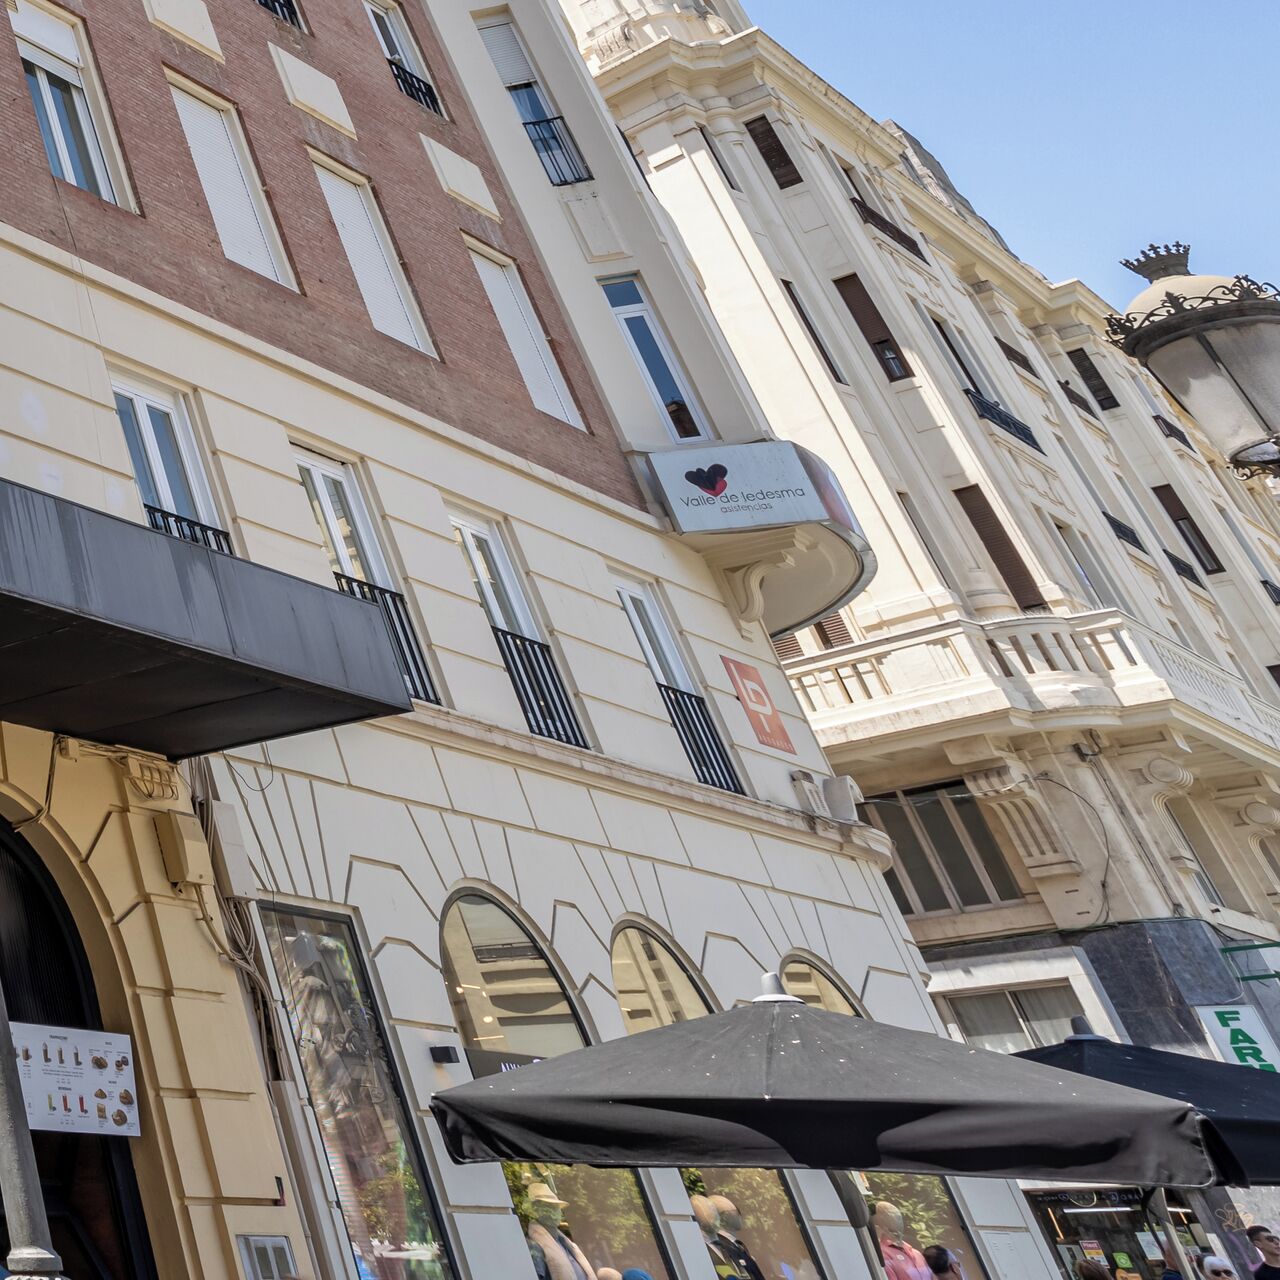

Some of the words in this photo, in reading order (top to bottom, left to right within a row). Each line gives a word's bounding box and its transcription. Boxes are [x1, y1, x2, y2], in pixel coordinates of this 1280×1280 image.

[680, 495, 716, 507] Valle
[720, 493, 739, 504] de
[721, 502, 773, 514] asistencias
